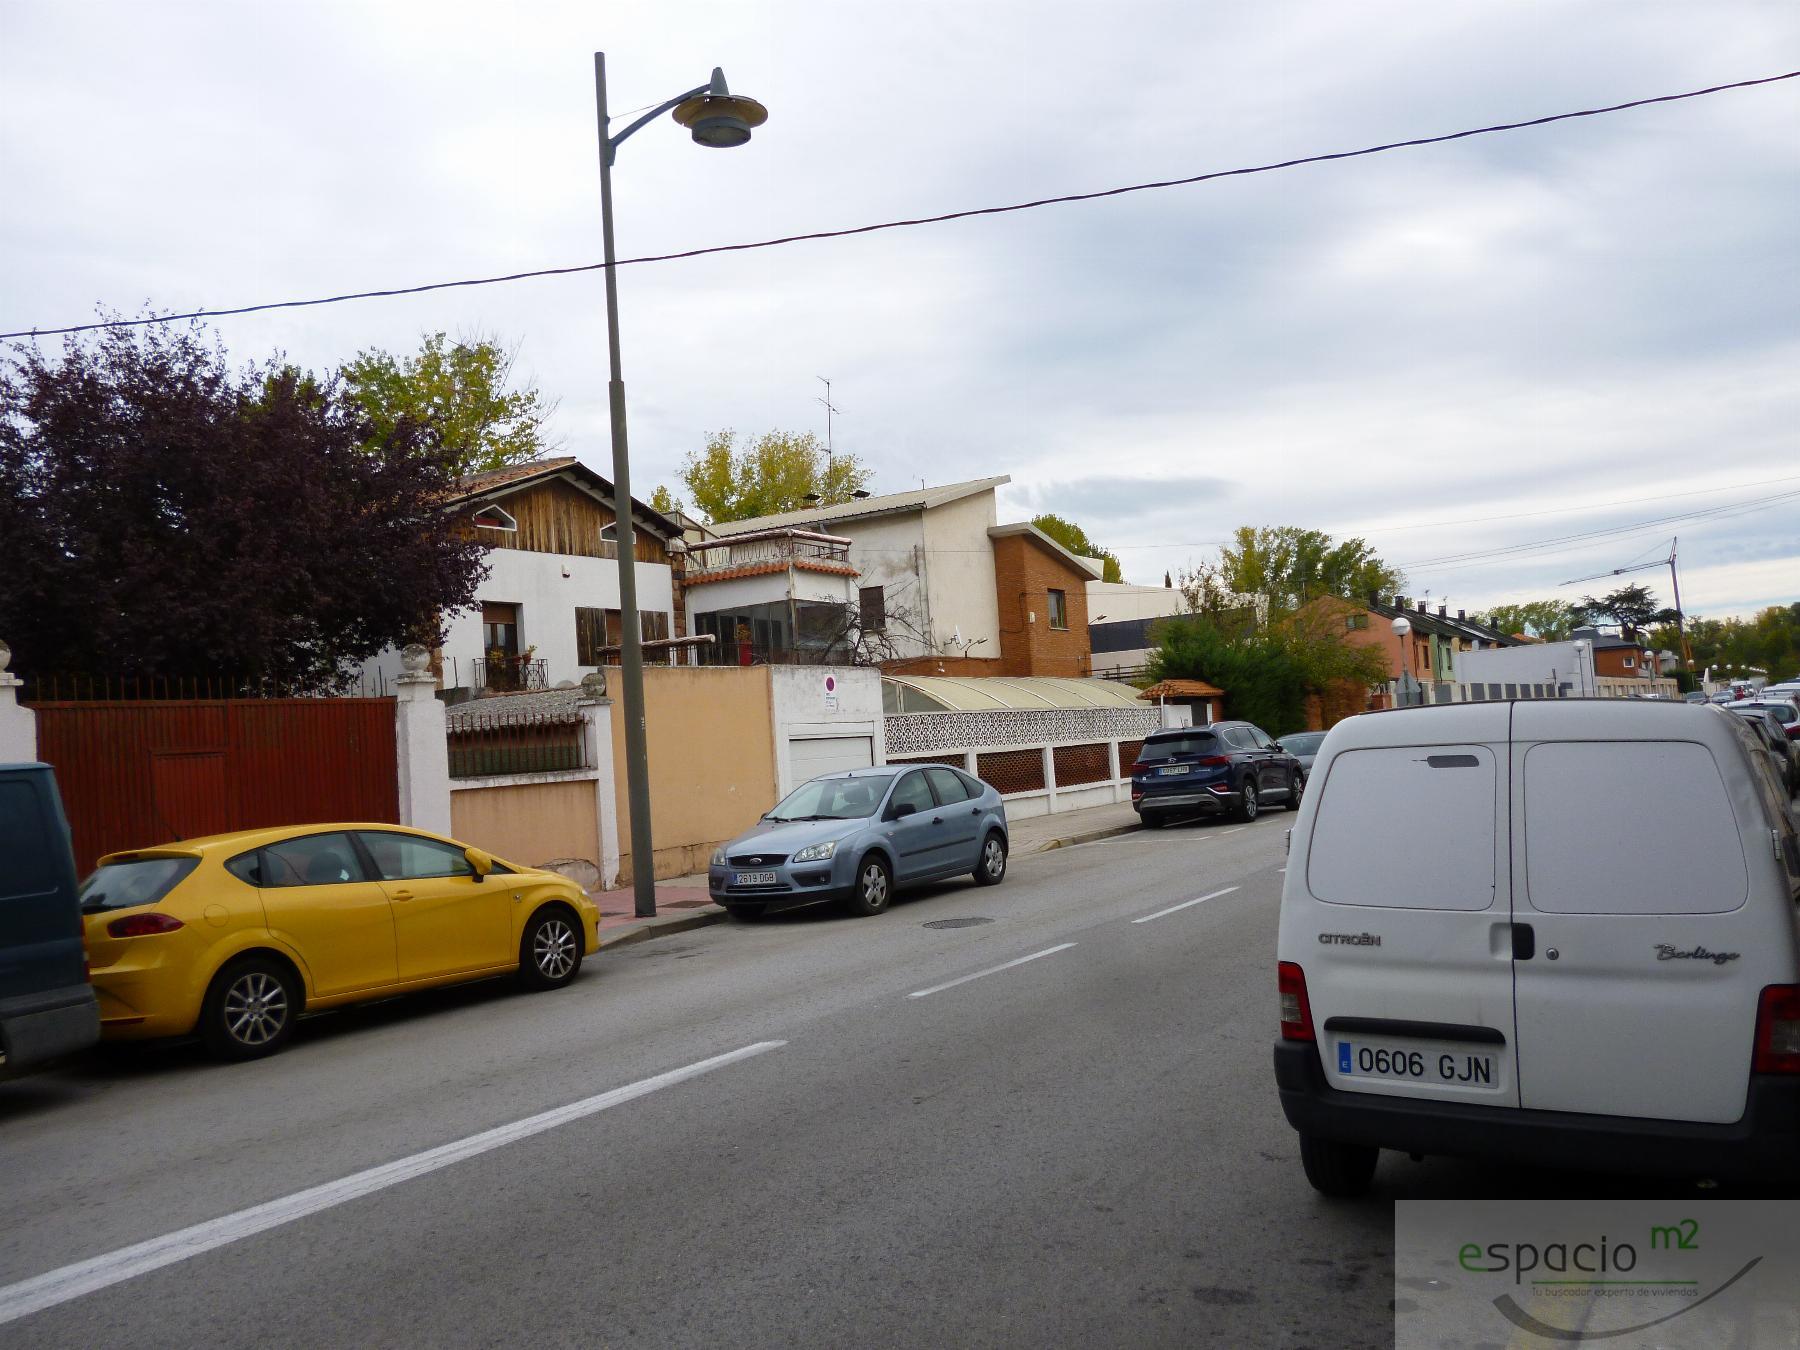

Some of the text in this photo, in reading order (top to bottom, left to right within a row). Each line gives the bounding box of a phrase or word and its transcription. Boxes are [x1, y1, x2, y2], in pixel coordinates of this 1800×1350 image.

[1318, 933, 1381, 946] CITROËN
[1654, 943, 1740, 965] Berlingo
[1359, 1048, 1490, 1083] 0606 GJN
